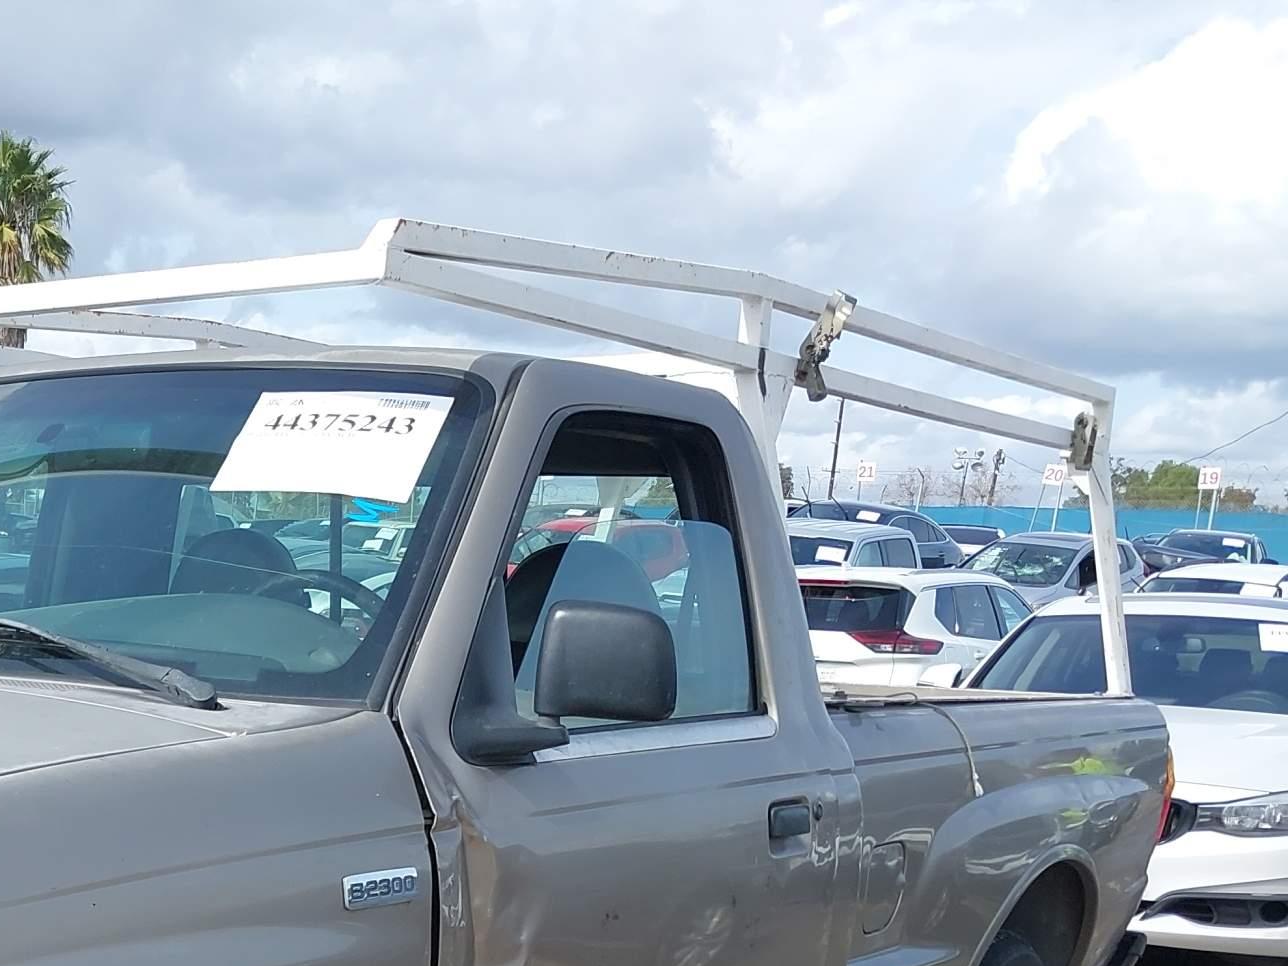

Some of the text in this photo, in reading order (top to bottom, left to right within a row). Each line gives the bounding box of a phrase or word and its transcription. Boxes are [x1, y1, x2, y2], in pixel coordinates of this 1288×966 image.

[264, 413, 416, 435] 44375243
[858, 465, 873, 478] 21
[1044, 468, 1063, 482] 20
[1199, 471, 1219, 485] 19
[349, 875, 415, 900] B2300
